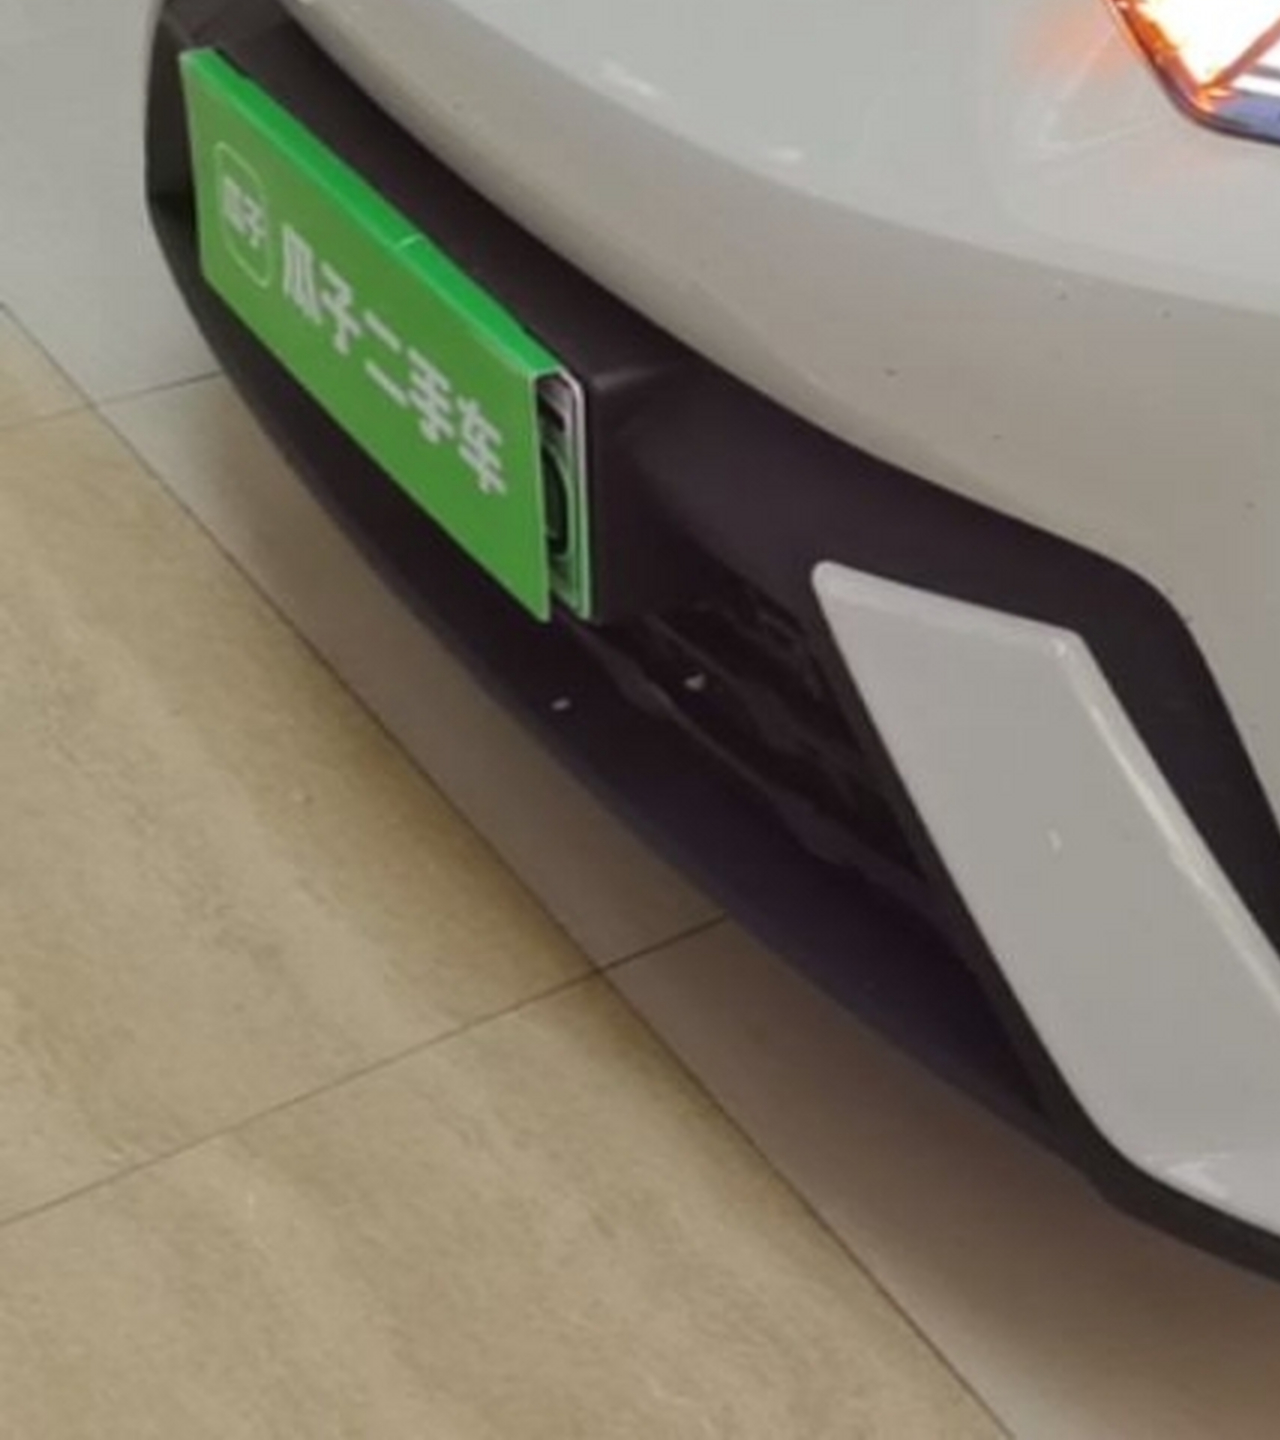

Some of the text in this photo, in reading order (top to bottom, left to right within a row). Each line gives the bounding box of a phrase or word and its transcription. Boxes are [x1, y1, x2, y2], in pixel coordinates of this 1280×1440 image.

[283, 222, 507, 495] 瓜子二手车
